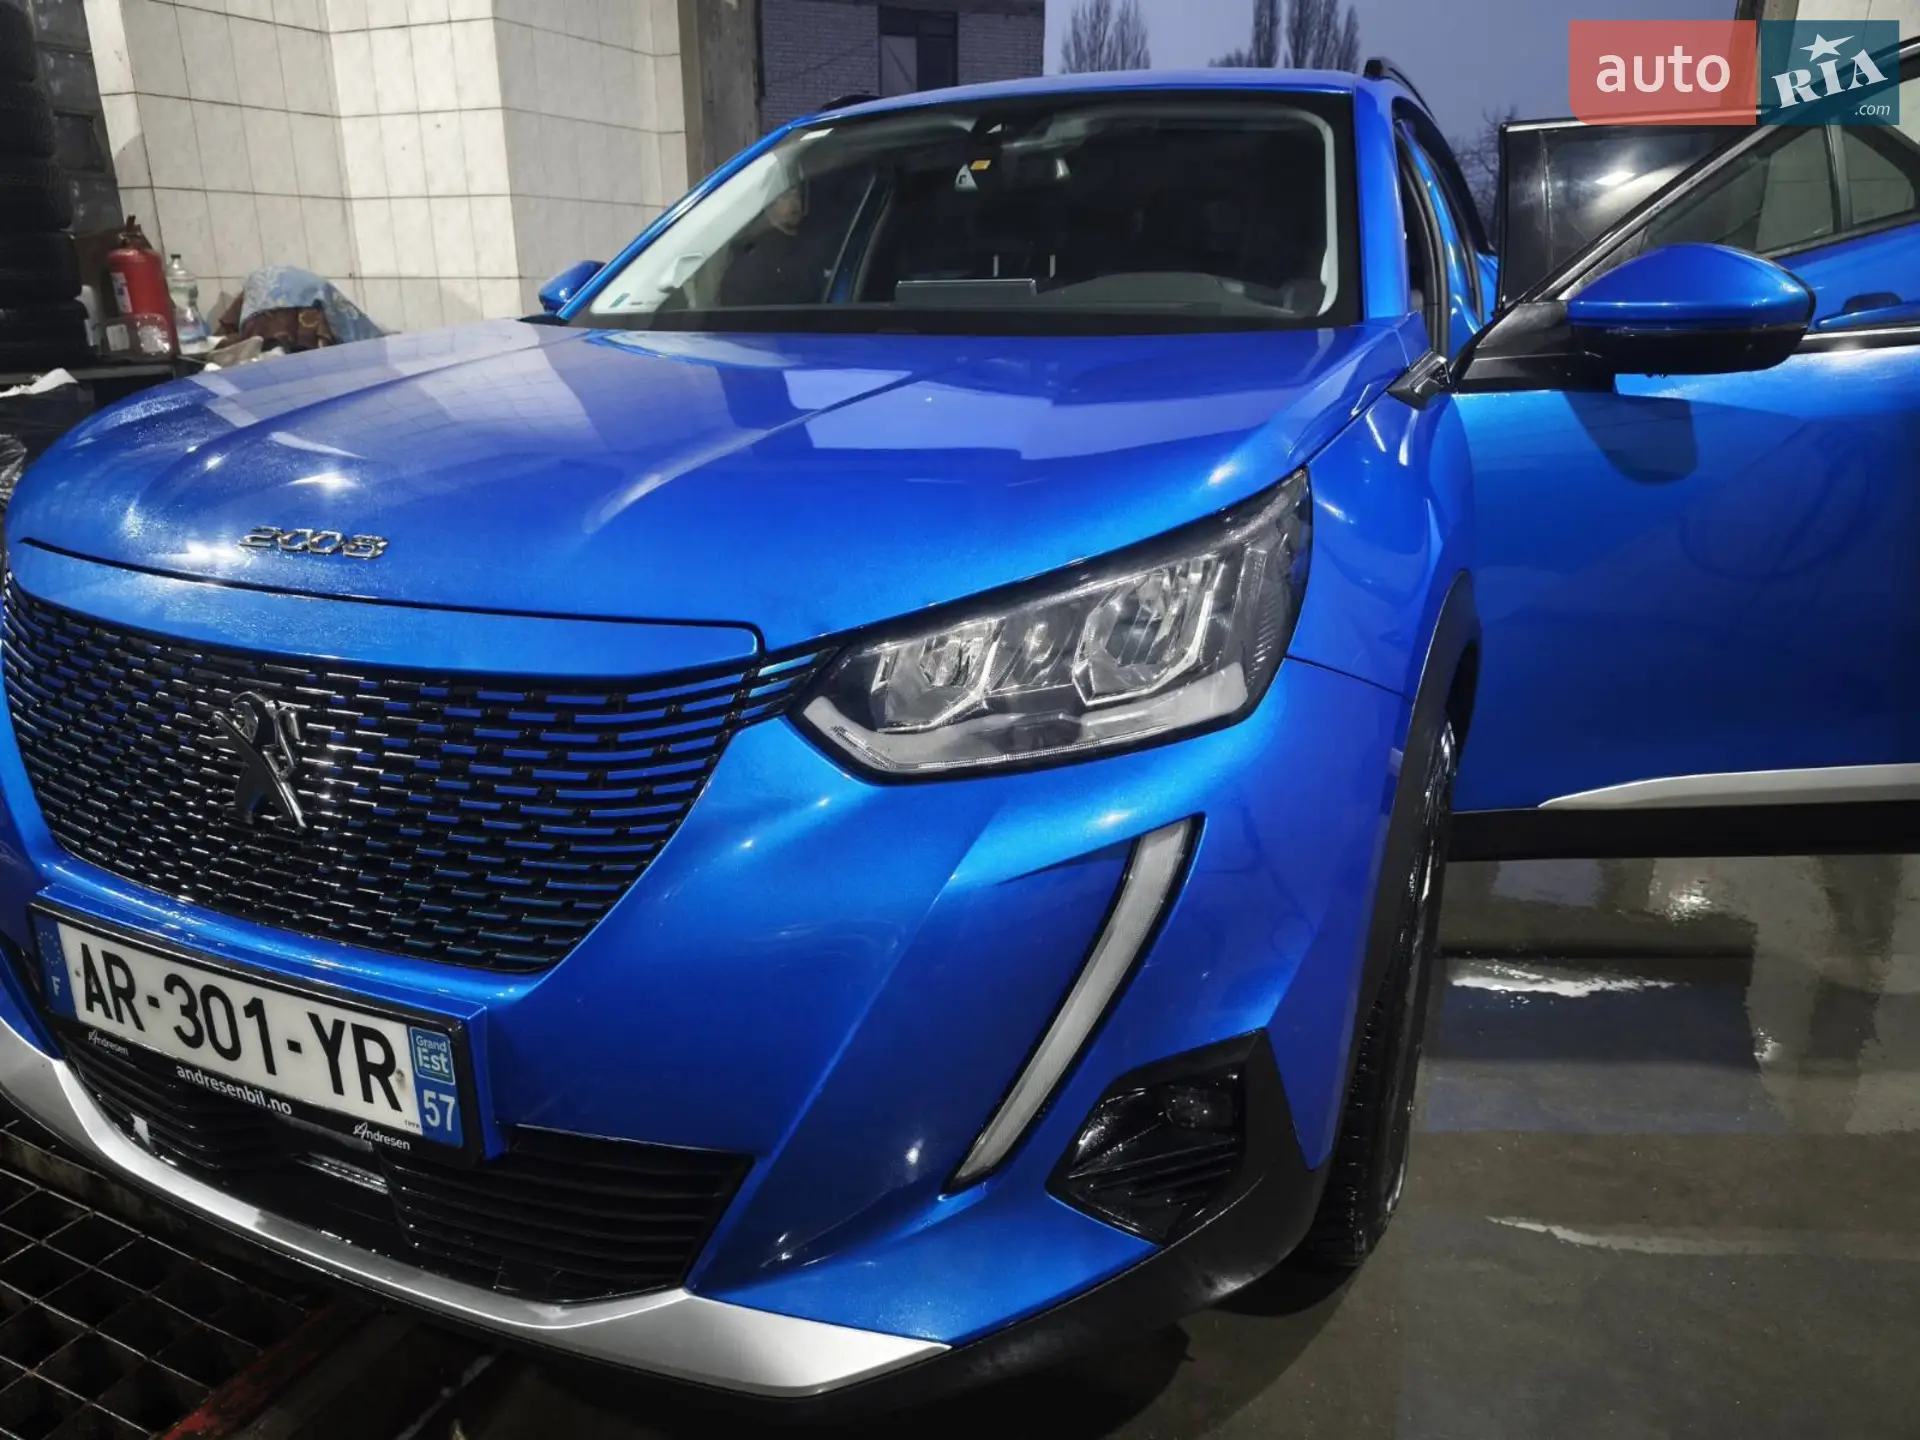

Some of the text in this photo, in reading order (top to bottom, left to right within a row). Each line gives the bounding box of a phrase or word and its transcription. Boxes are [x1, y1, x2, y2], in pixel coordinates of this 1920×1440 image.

[237, 525, 388, 560] 2008
[51, 975, 61, 996] F
[81, 942, 402, 1113] AR-301-YR
[416, 1035, 448, 1053] Grand
[417, 1046, 449, 1074] Est
[176, 1065, 293, 1115] andresenbil.no
[423, 1089, 456, 1132] 57
[353, 1121, 410, 1150] Andresen
